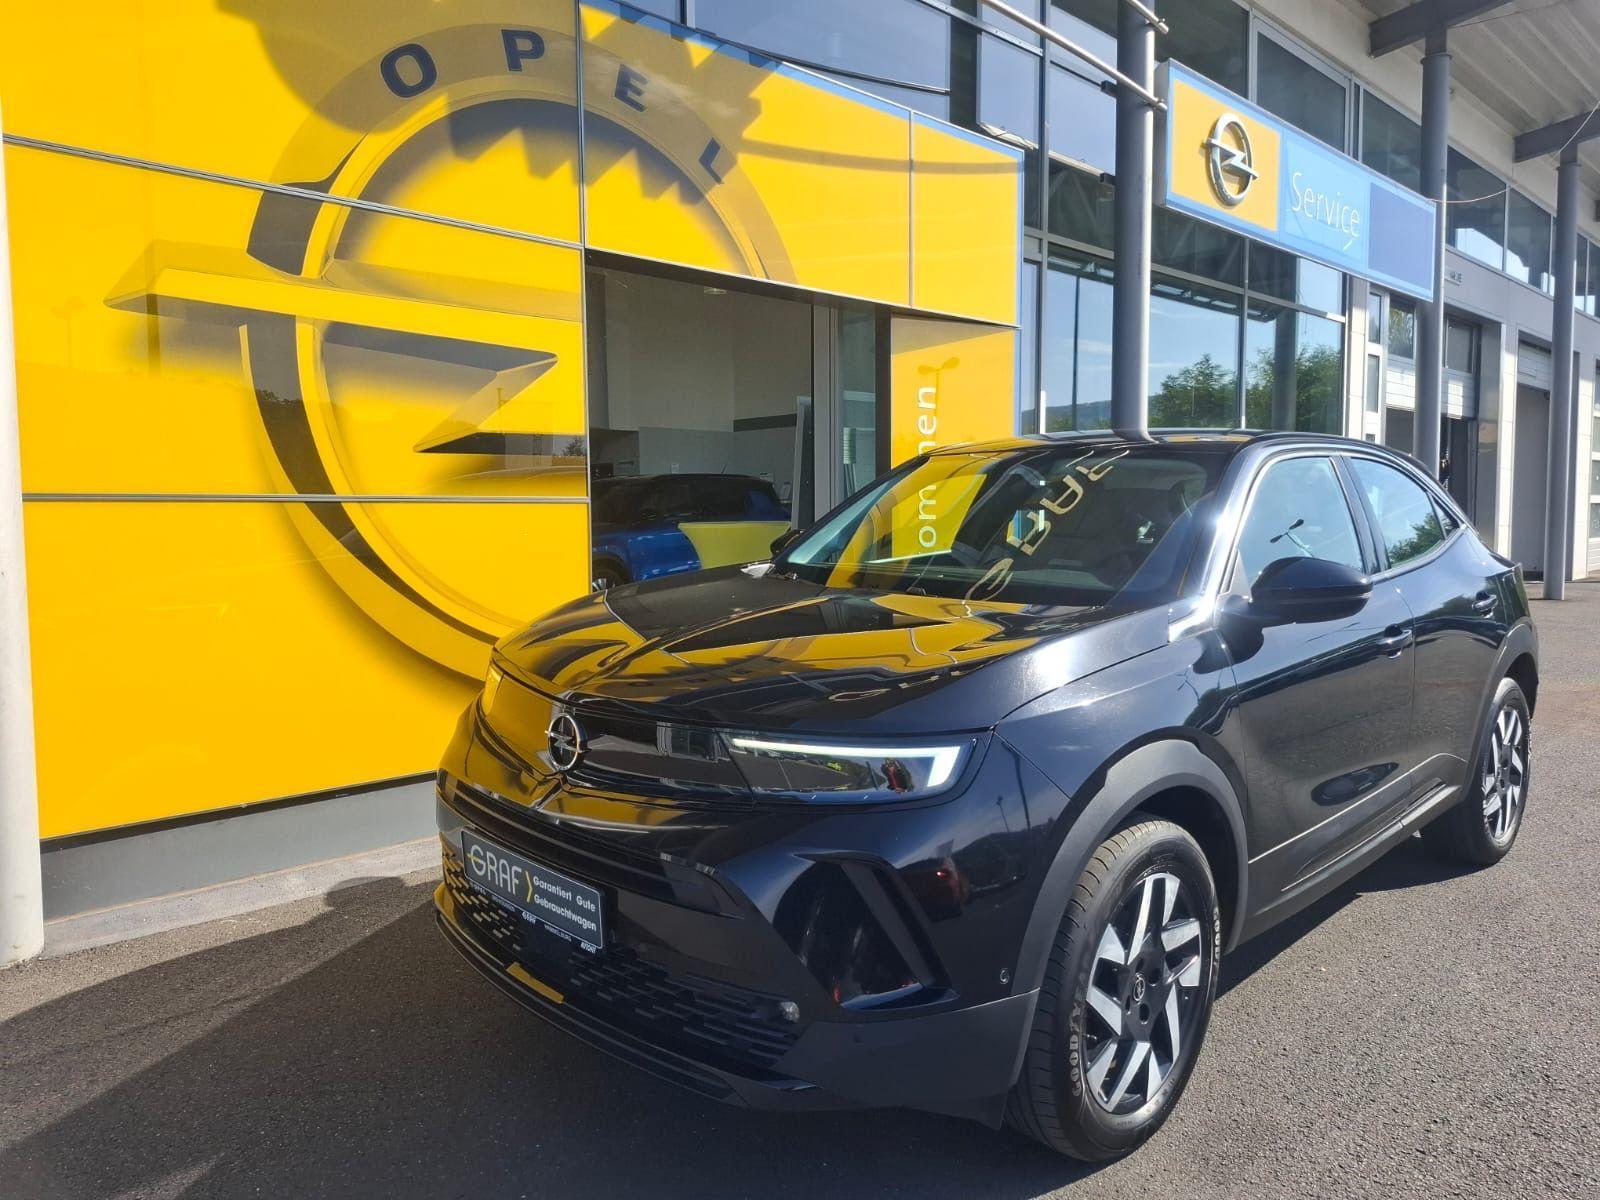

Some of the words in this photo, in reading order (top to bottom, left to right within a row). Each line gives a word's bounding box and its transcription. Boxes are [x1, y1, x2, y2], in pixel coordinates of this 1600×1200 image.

[379, 28, 726, 185] OPEL
[1290, 171, 1361, 238] Service
[469, 844, 522, 896] GRAF
[533, 876, 572, 901] Garantiert
[576, 895, 596, 912] Gute
[533, 894, 597, 932] Gebrauchtwagen
